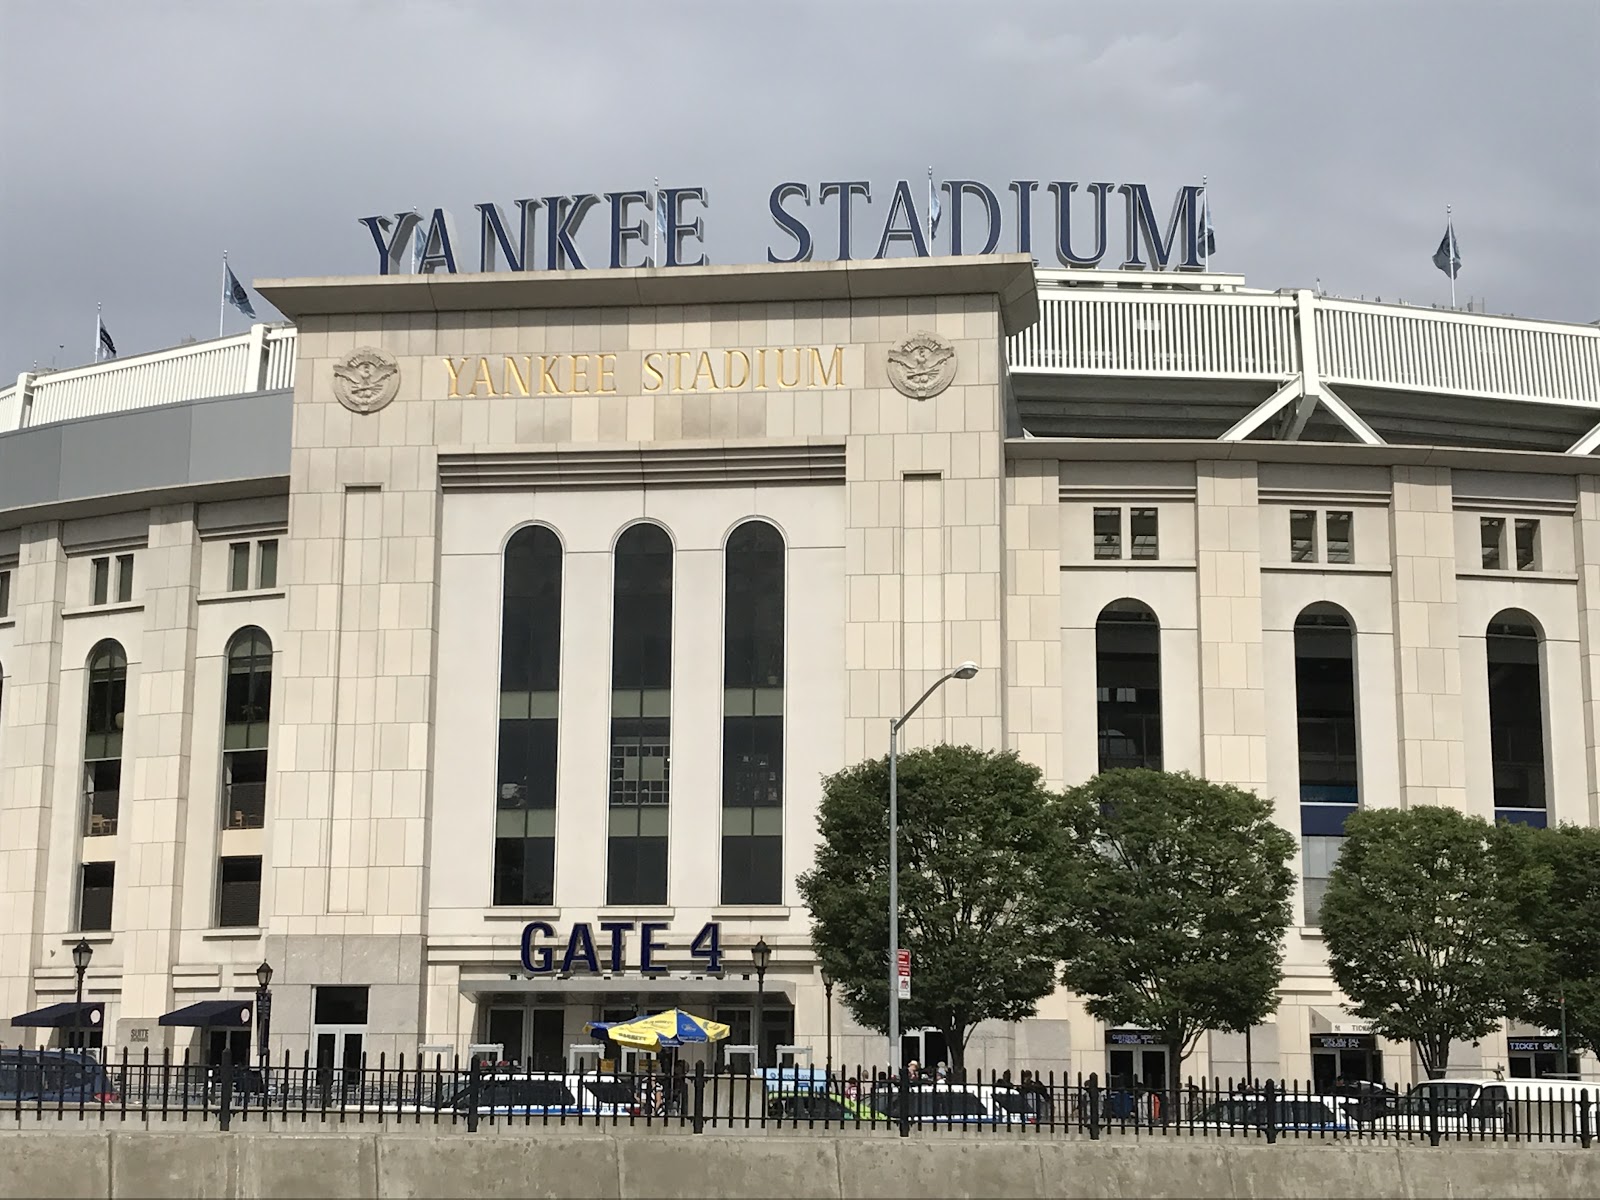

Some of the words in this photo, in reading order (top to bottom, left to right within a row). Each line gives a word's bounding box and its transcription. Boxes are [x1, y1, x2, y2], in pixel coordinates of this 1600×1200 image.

[359, 187, 708, 275] YANKEE
[767, 180, 1205, 271] STADIUM
[443, 352, 618, 399] YANKEE
[642, 345, 846, 394] STADIUM
[520, 921, 671, 975] GATE
[690, 922, 724, 976] 4
